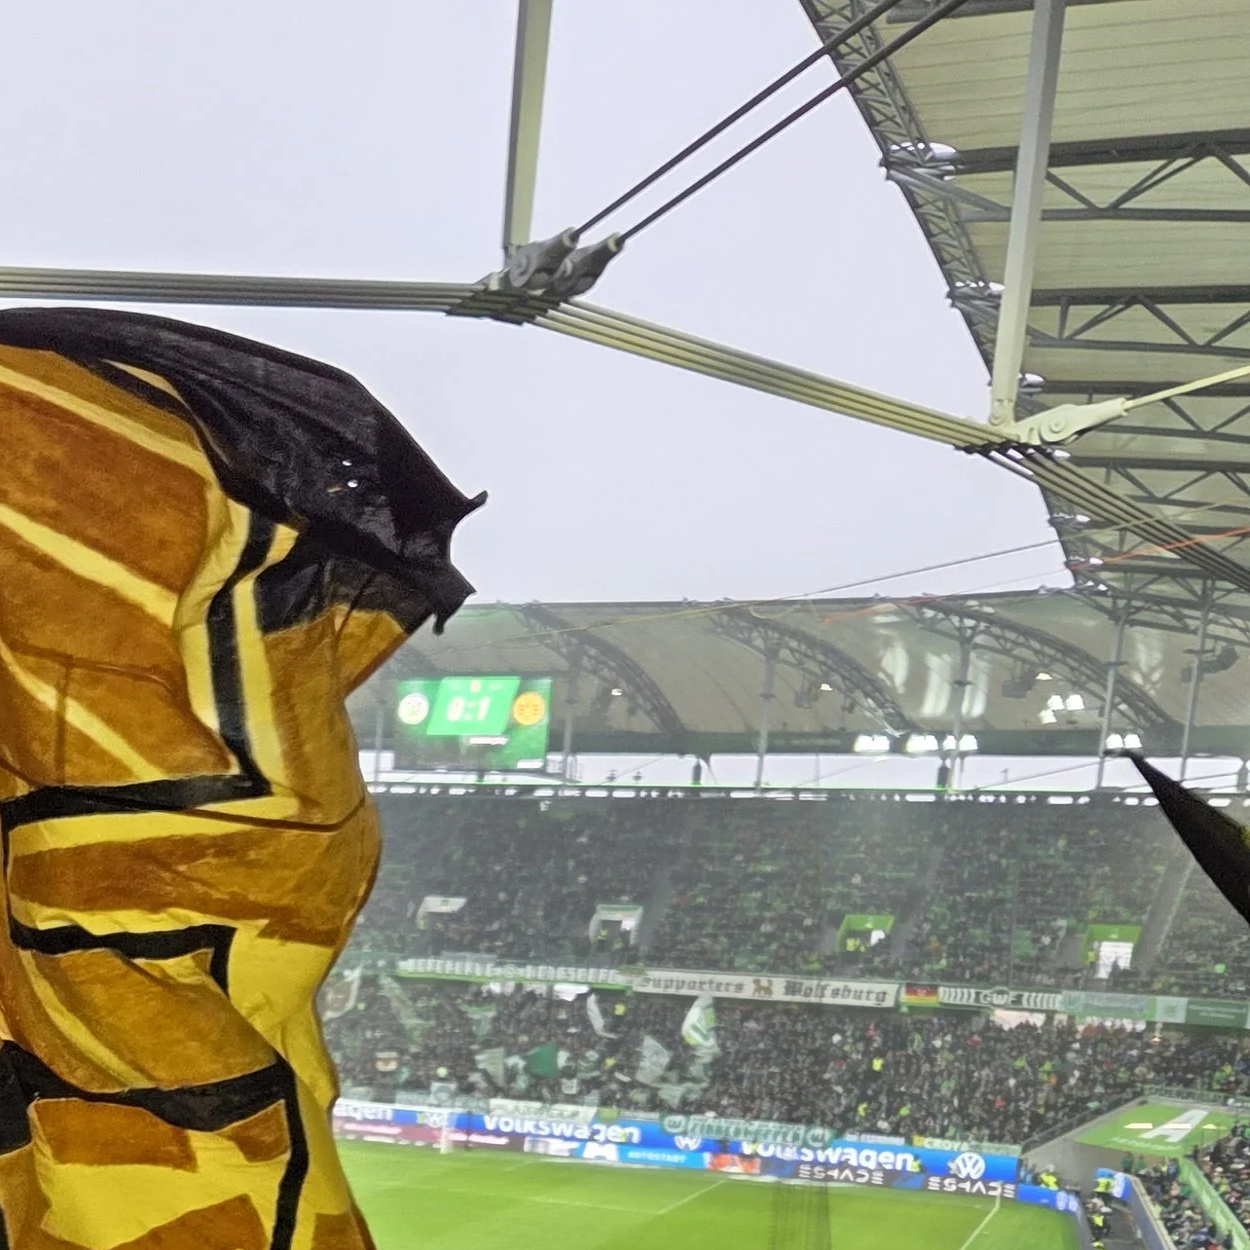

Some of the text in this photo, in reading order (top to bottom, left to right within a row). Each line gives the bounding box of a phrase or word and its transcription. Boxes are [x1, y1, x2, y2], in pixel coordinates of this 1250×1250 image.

[446, 696, 491, 722] 0:1
[783, 978, 888, 1006] Wolfsburg
[483, 1114, 642, 1144] Volkswagen
